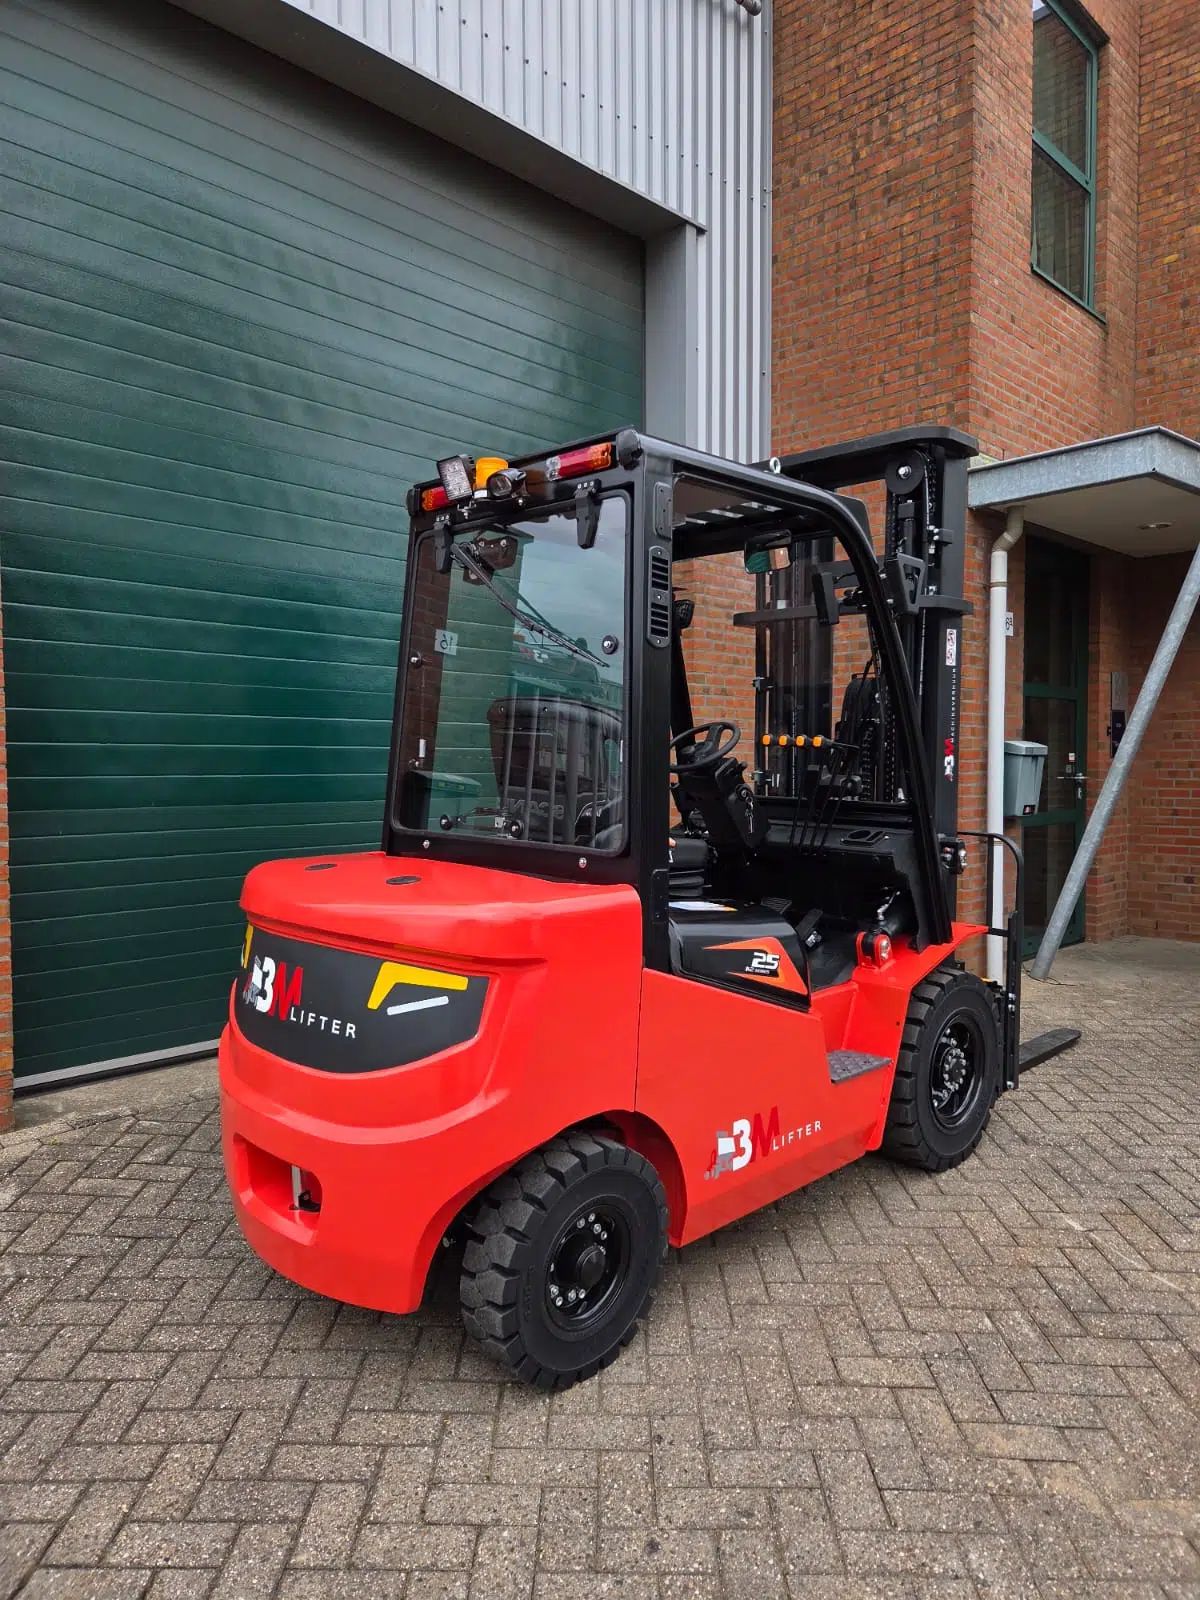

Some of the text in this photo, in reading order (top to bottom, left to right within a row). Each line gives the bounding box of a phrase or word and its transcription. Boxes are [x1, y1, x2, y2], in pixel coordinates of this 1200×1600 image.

[751, 951, 780, 970] 25
[290, 1006, 356, 1039] LIFTER
[772, 1120, 822, 1151] LIFTER
